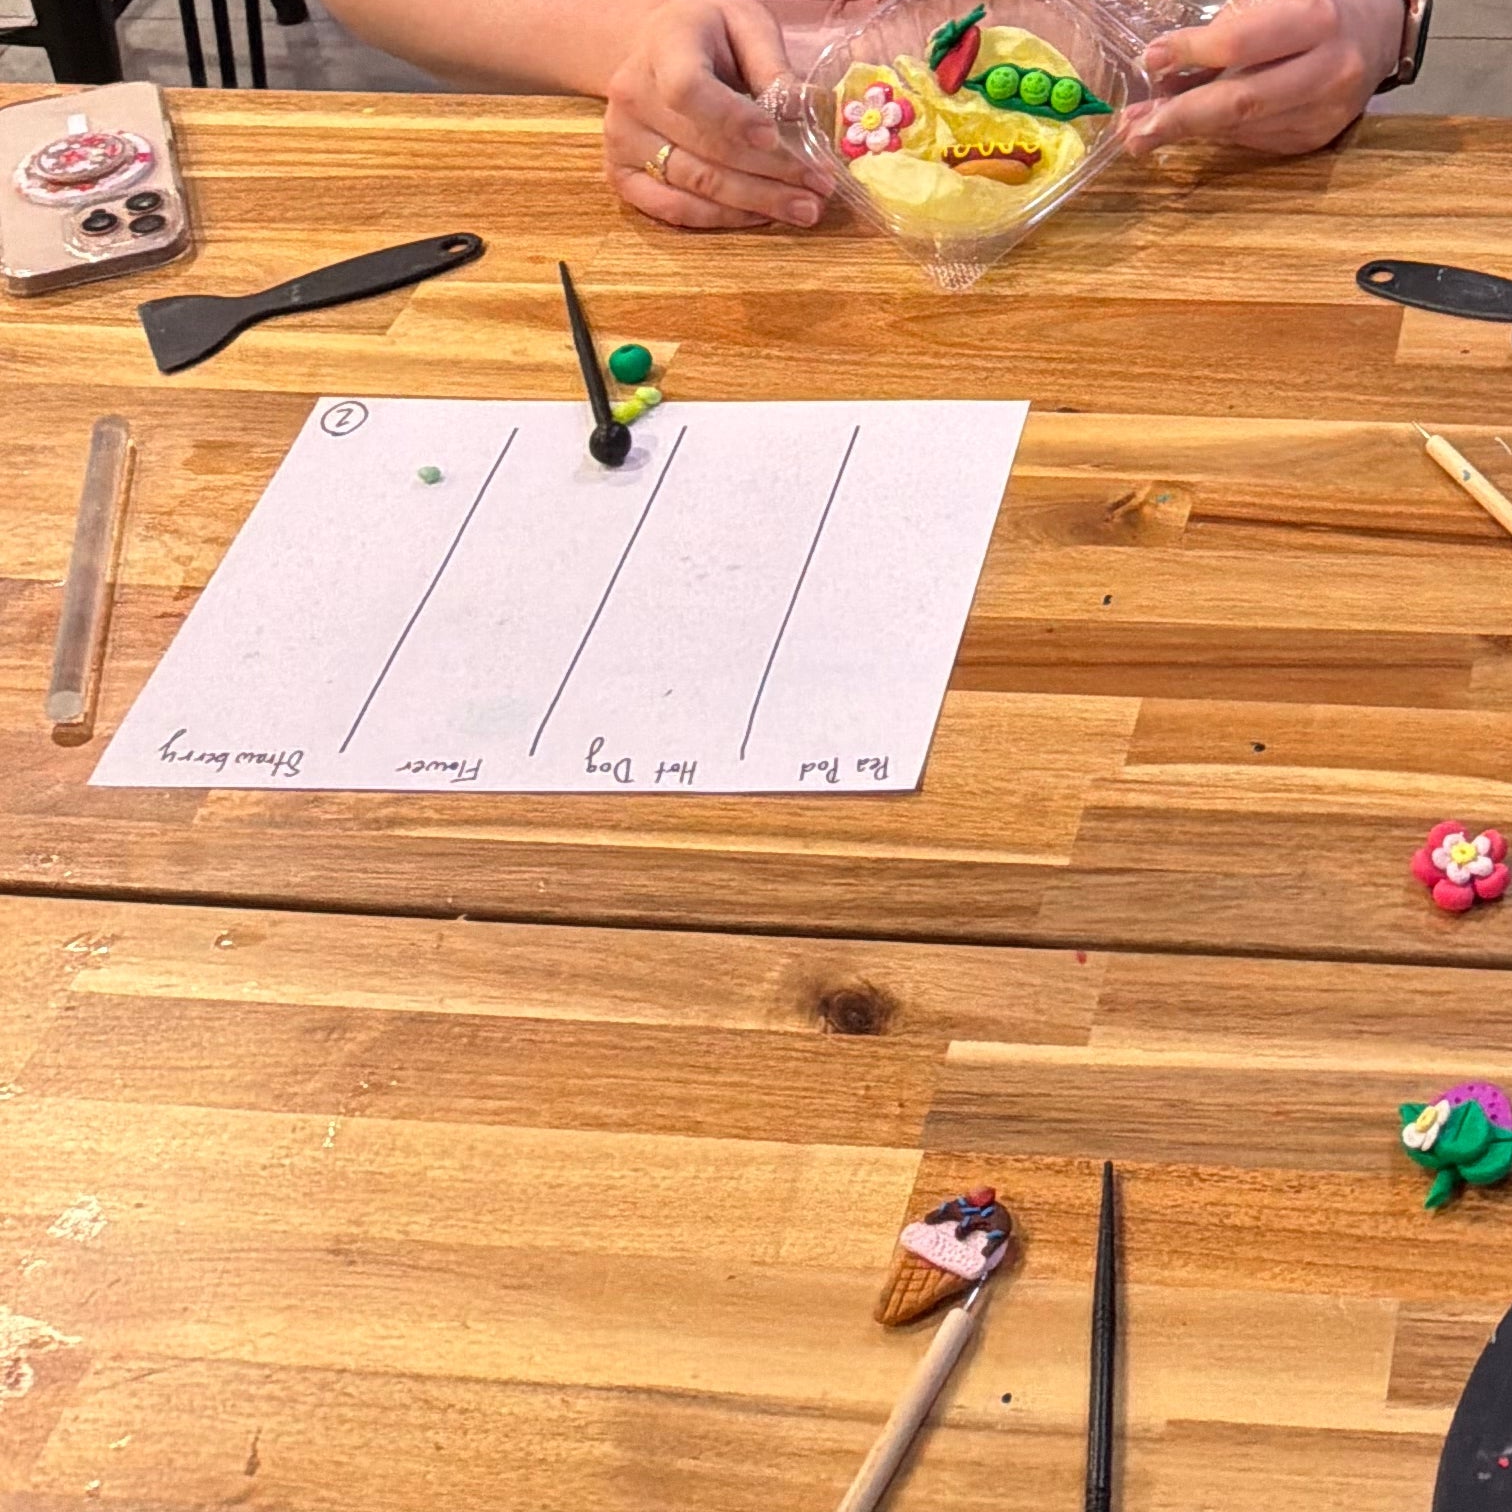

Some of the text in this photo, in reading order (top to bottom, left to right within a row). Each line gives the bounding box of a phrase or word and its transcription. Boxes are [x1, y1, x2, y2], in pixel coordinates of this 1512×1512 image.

[395, 758, 484, 784] Flower
[585, 736, 698, 786] Hot Dog
[799, 755, 890, 784] Pea Pod
